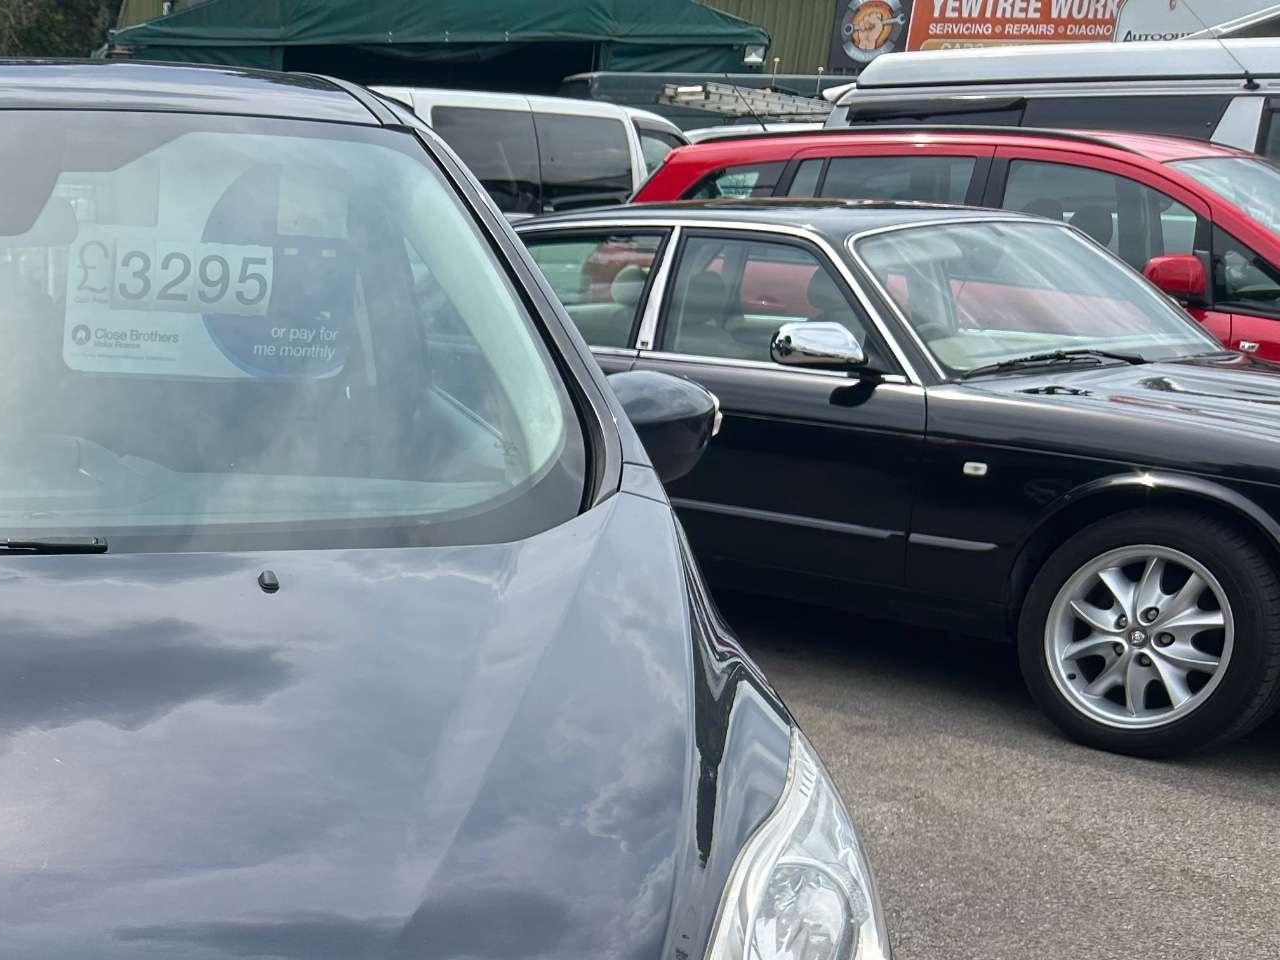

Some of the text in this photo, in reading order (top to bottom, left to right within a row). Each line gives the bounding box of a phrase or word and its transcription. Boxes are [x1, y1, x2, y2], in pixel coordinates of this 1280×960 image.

[932, 0, 1042, 18] YEWTREE
[928, 22, 1113, 35] SERVICING REPAIRS DIAGNO
[94, 327, 179, 344] Close Brothers
[271, 327, 287, 338] or
[288, 328, 316, 343] pay
[253, 344, 337, 360] me monthly
